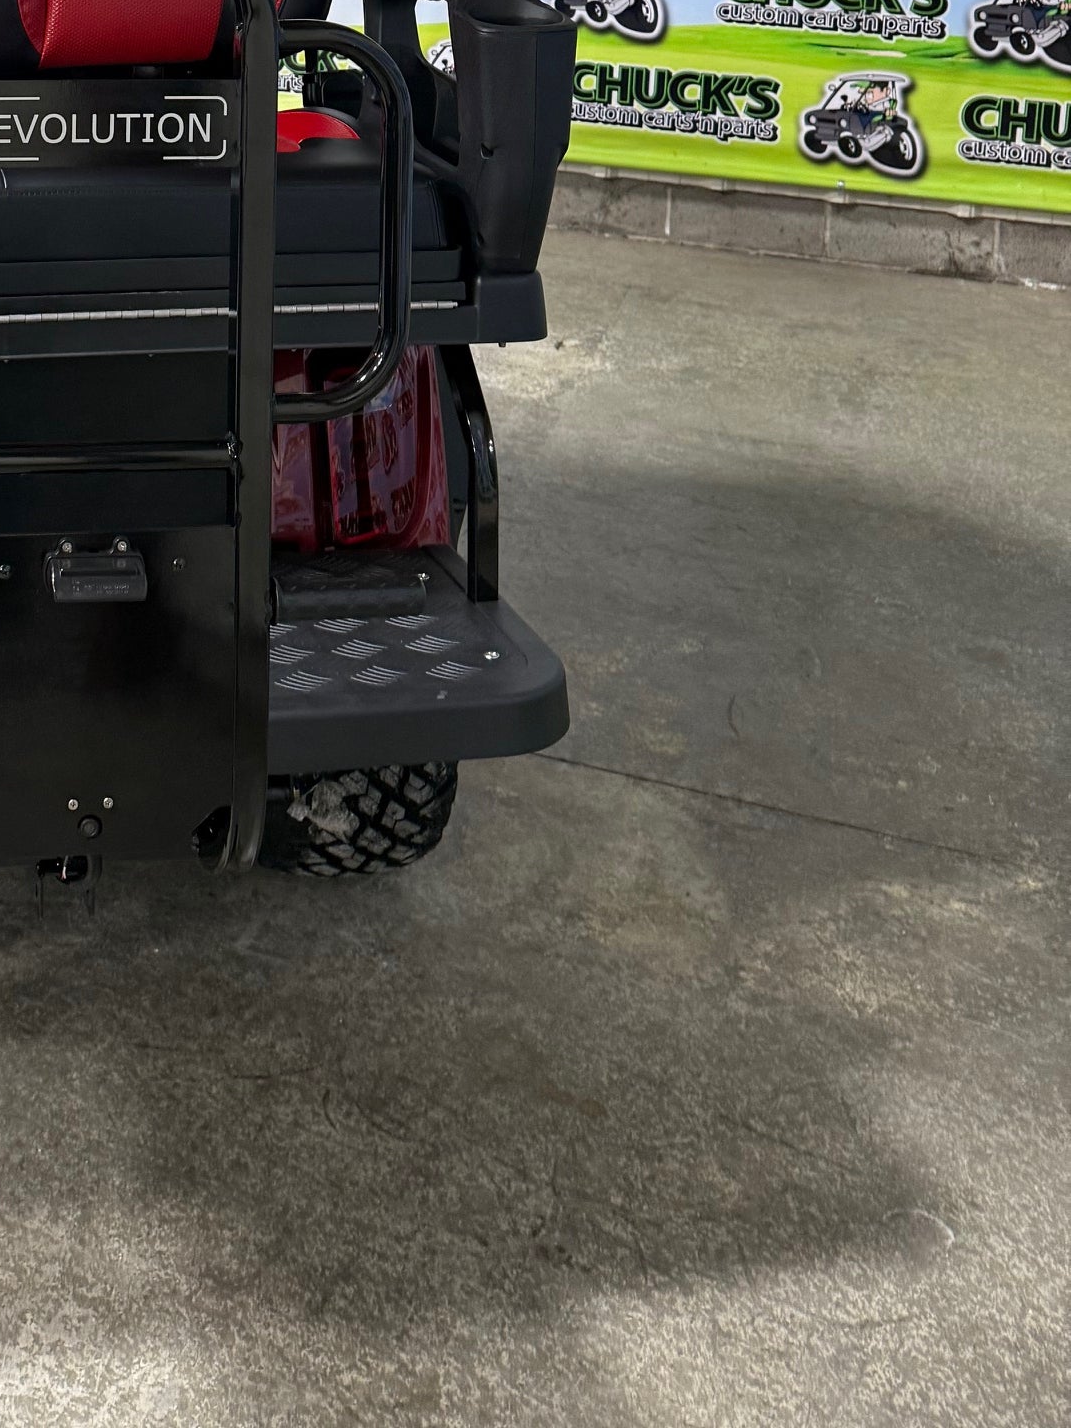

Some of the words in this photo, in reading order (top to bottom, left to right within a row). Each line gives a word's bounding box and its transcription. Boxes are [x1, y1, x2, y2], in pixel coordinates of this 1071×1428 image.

[717, 3, 803, 28] custom
[803, 8, 856, 31] carts
[882, 14, 946, 40] parts
[574, 61, 780, 120] CHUCK'S
[571, 103, 643, 128] ustom
[643, 108, 695, 131] carts
[718, 115, 777, 141] parts
[958, 139, 1051, 167] custom
